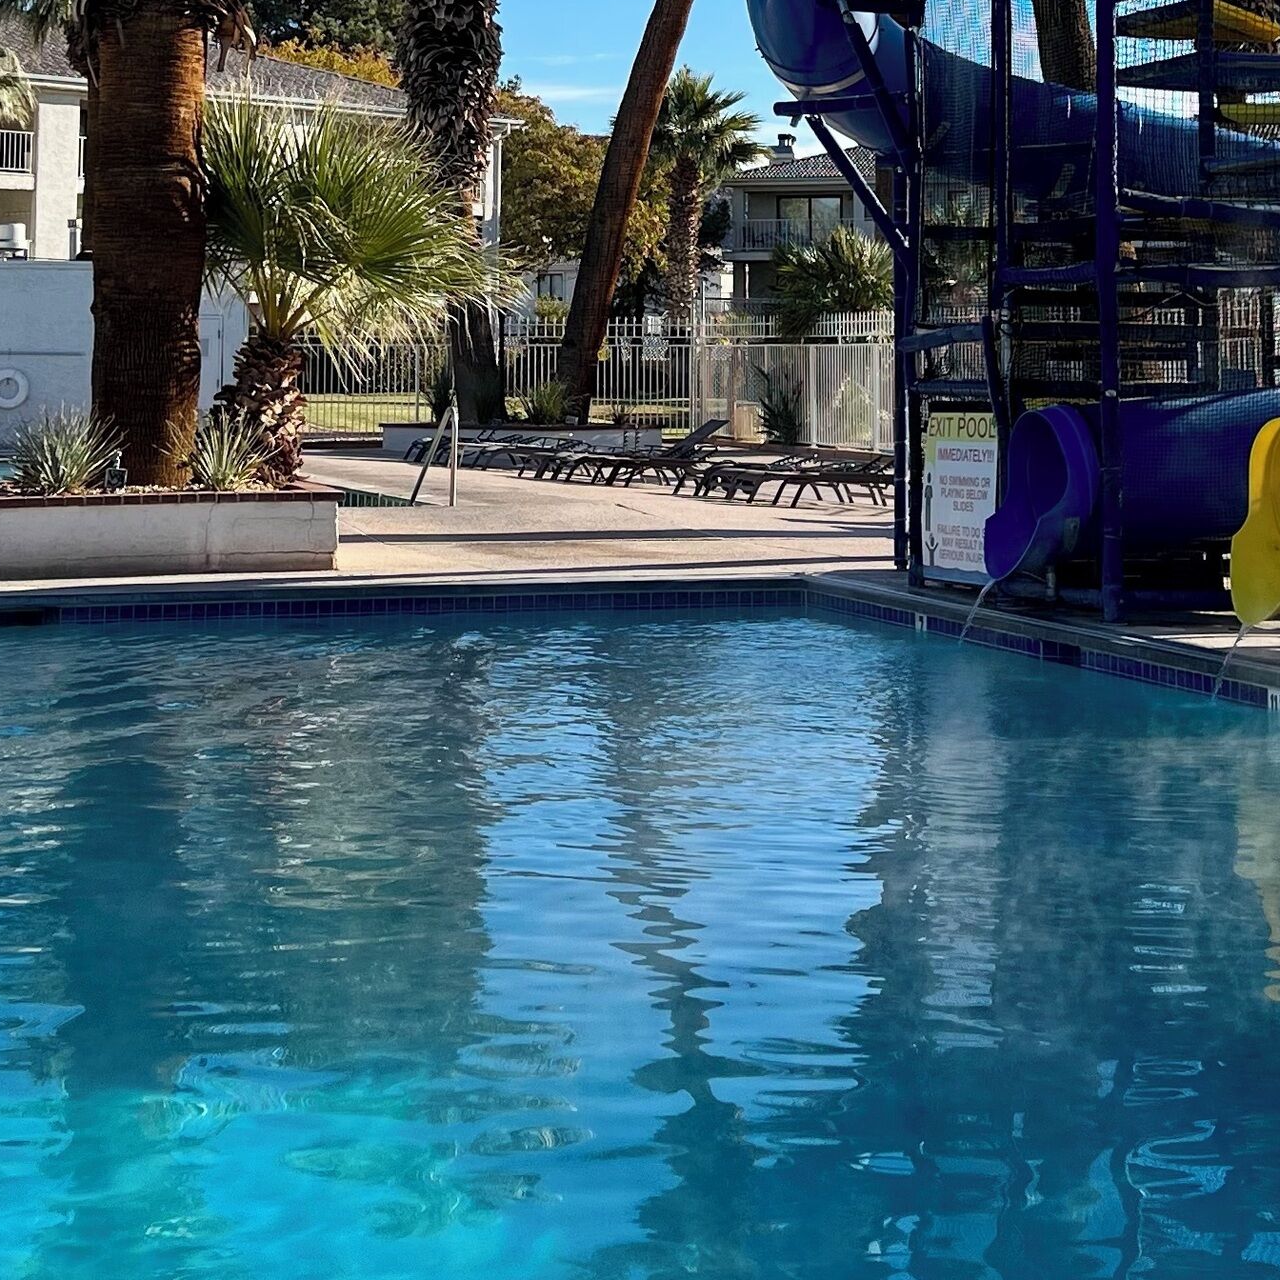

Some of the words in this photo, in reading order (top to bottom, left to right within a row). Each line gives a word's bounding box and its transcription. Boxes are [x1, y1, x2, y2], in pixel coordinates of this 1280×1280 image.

[929, 417, 954, 437] EXIT
[957, 417, 996, 438] POOL
[939, 475, 948, 486] NO
[981, 477, 991, 488] OR
[941, 488, 965, 499] PLAYING
[966, 489, 989, 500] BELOW
[953, 501, 974, 512] SLIDES
[961, 526, 970, 537] TO
[971, 527, 980, 538] DO
